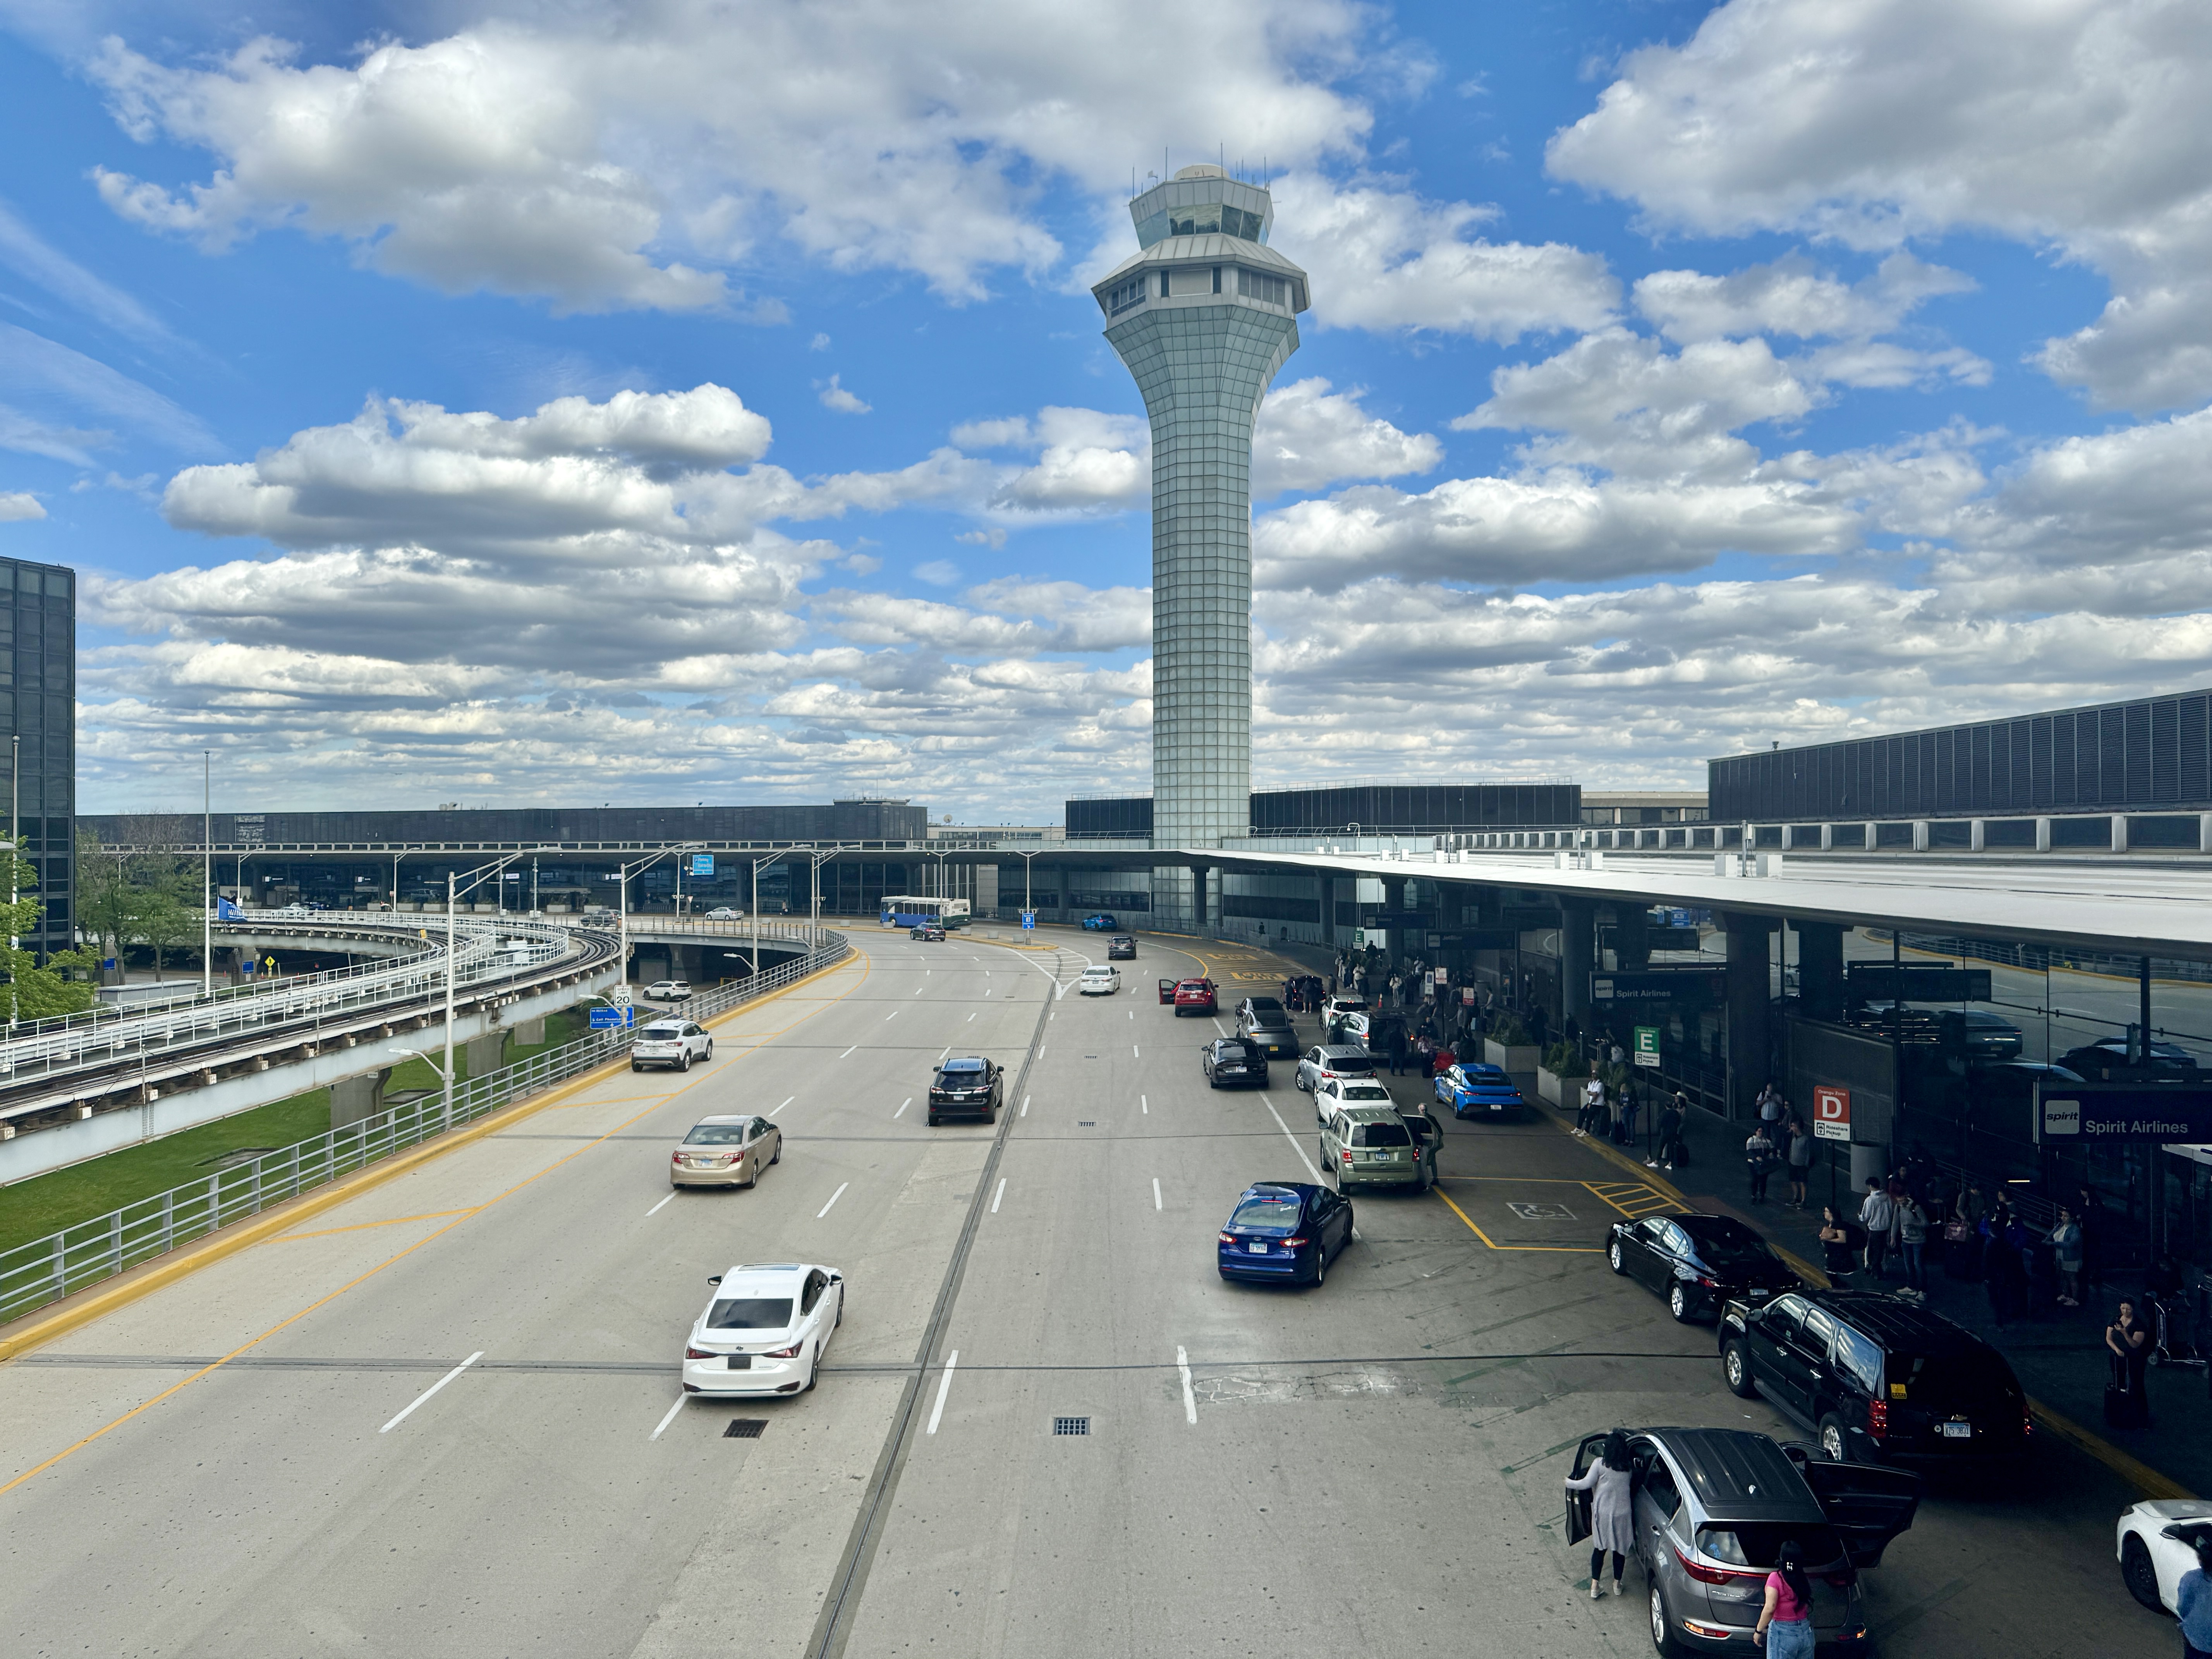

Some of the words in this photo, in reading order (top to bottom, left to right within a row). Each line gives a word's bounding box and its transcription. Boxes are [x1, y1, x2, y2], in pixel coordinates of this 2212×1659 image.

[1641, 1033, 1653, 1051] E
[1822, 1095, 1842, 1118] D
[2046, 1112, 2078, 1121] spirit
[2085, 1120, 2126, 1135] Spirit
[2131, 1120, 2188, 1133] Airlines
